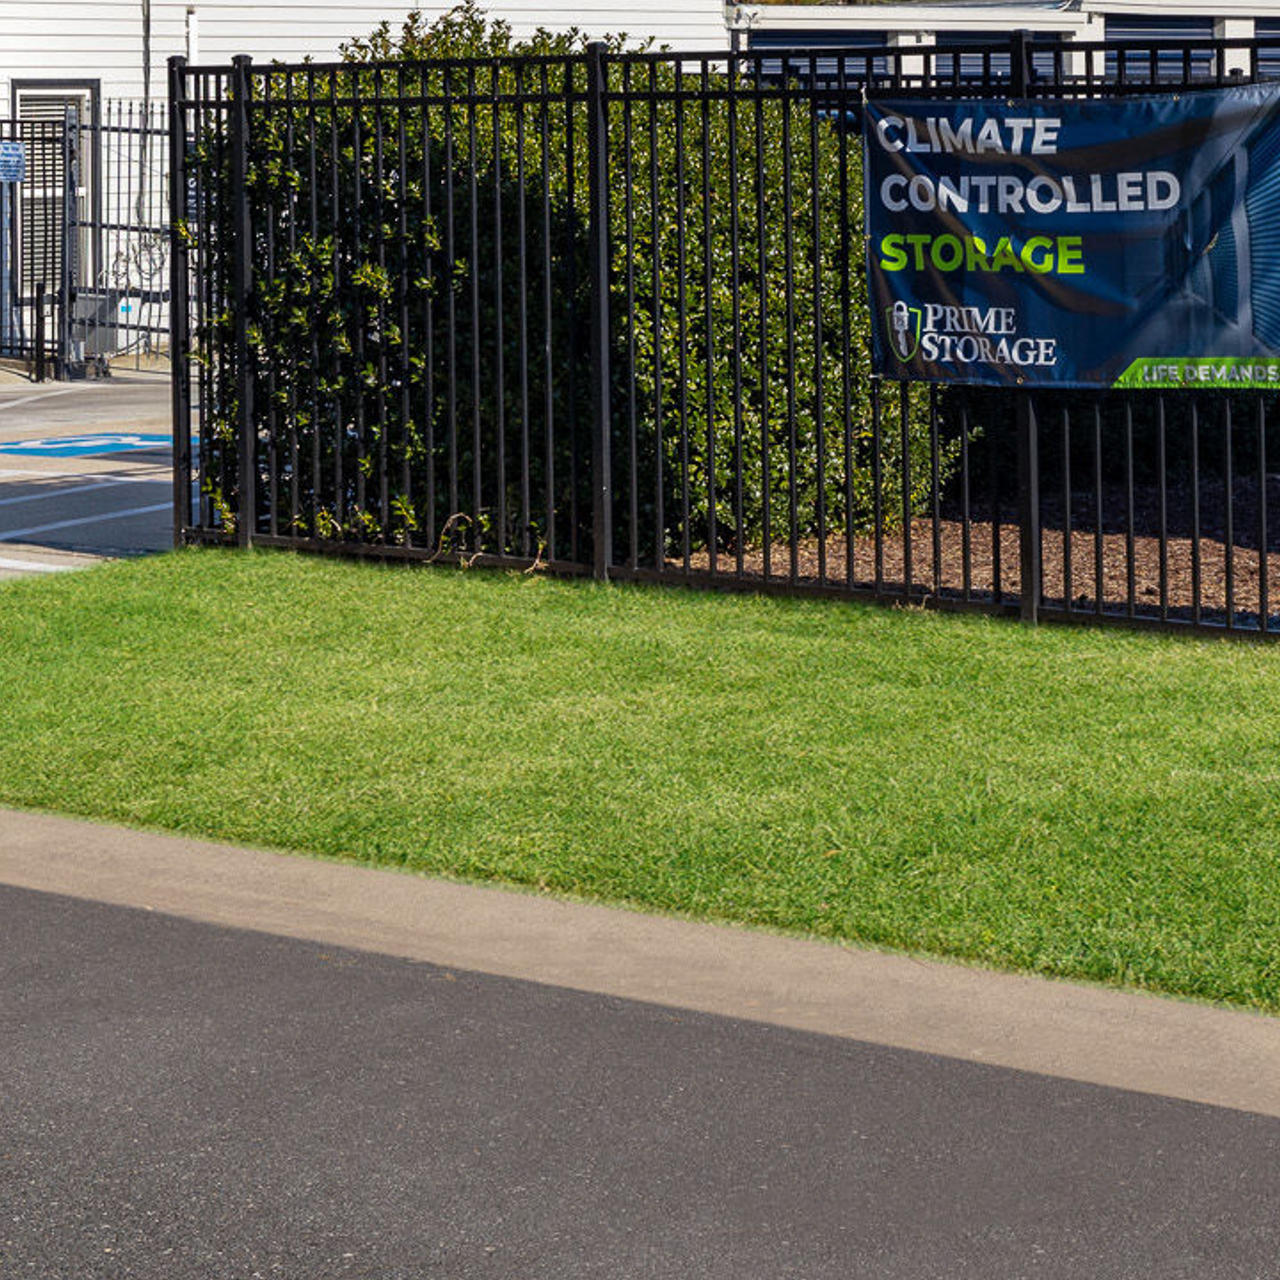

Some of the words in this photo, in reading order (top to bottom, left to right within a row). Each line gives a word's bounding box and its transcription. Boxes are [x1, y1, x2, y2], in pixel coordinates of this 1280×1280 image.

[876, 116, 1061, 155] CLIMATE
[880, 171, 1180, 213] CONTROLLED
[880, 233, 1085, 275] STORAGE
[923, 303, 1017, 333] PRIME
[921, 333, 1057, 366] STORAGE
[1143, 365, 1180, 382] LIFE
[1185, 365, 1280, 382] DEMANDS
